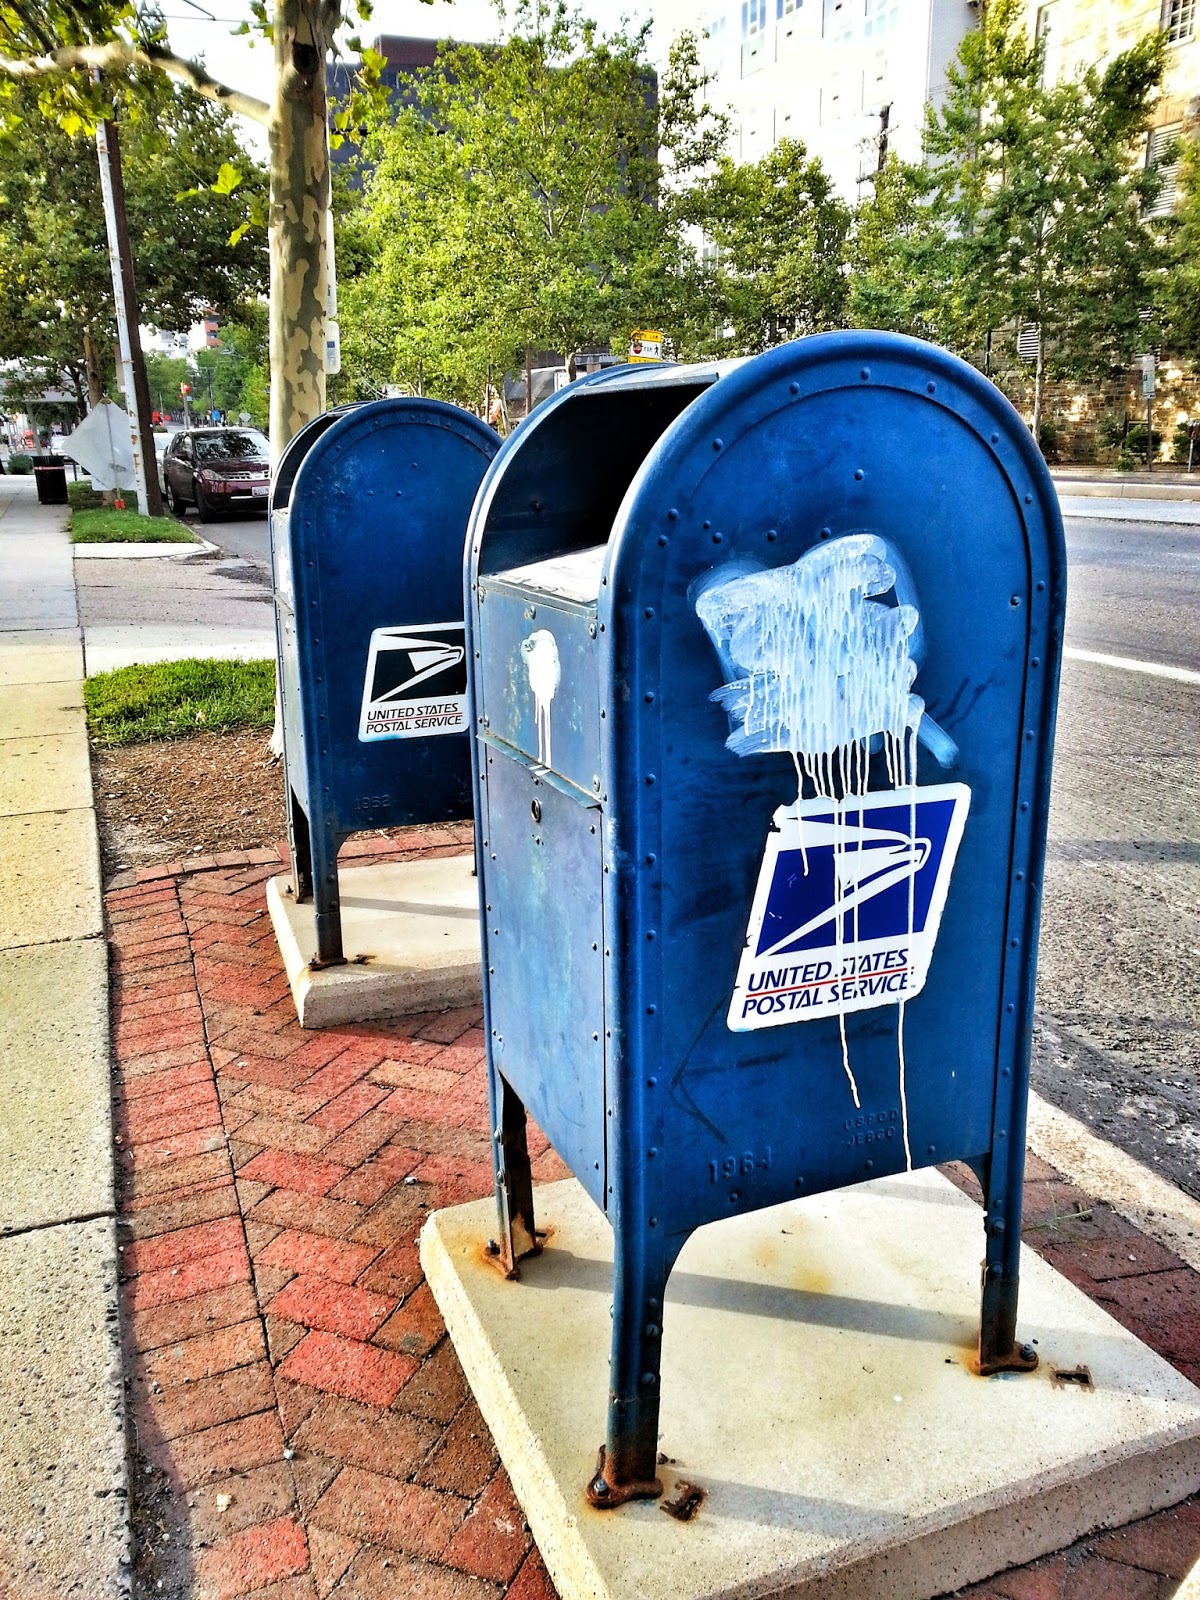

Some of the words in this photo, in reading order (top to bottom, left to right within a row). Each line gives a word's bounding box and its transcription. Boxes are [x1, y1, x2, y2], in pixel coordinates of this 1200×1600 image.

[366, 720, 411, 734] POSTAL
[414, 715, 462, 729] SERVICE
[367, 707, 414, 720] UNITED
[417, 703, 458, 716] STATES
[748, 961, 832, 992] UNITED
[835, 948, 909, 977] STATES
[741, 987, 823, 1019] POSTAL
[827, 971, 914, 1002] SERVICE
